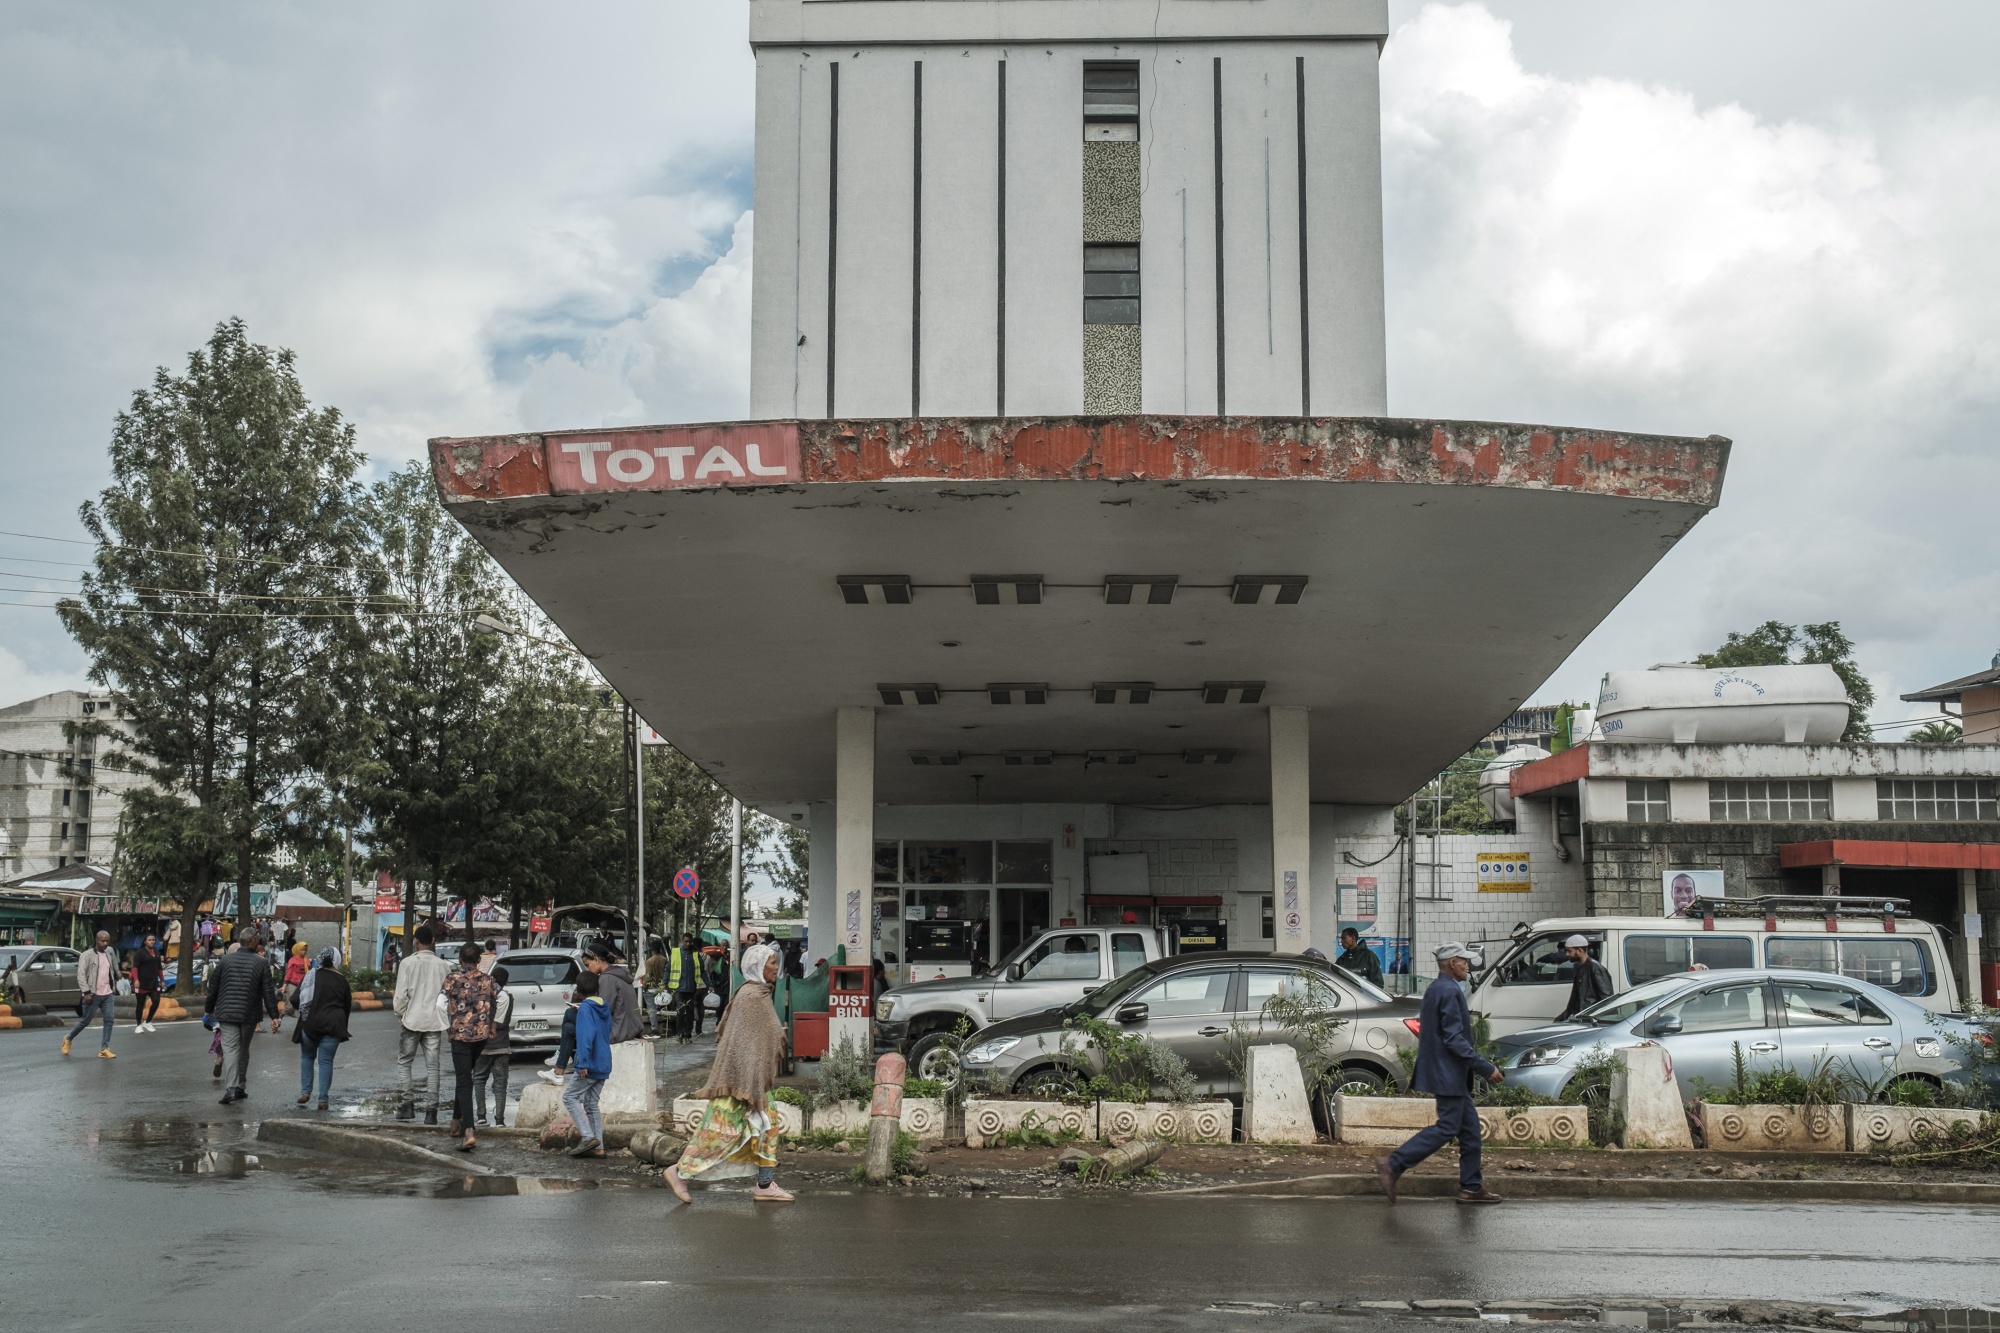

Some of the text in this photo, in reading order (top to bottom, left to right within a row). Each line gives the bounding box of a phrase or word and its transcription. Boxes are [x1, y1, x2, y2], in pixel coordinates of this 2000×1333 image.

[561, 441, 787, 484] TOTAL
[829, 995, 869, 1006] DUST
[836, 1007, 862, 1018] BIN
